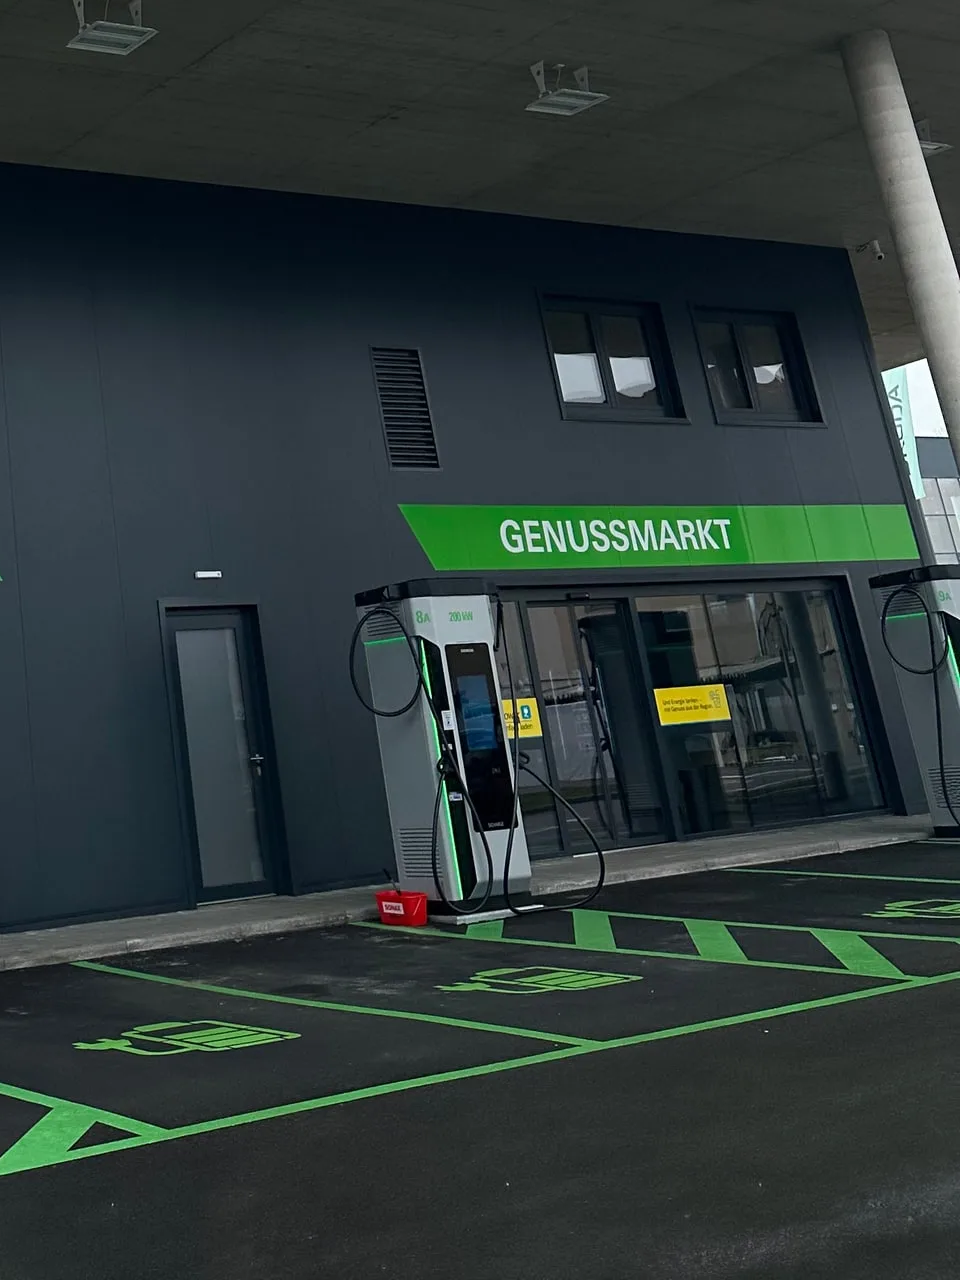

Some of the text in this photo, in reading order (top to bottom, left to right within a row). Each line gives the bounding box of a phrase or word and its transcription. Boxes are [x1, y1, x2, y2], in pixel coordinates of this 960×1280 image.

[499, 519, 731, 553] GENUSSMARKT
[938, 590, 951, 602] 9A
[416, 610, 430, 624] 8A
